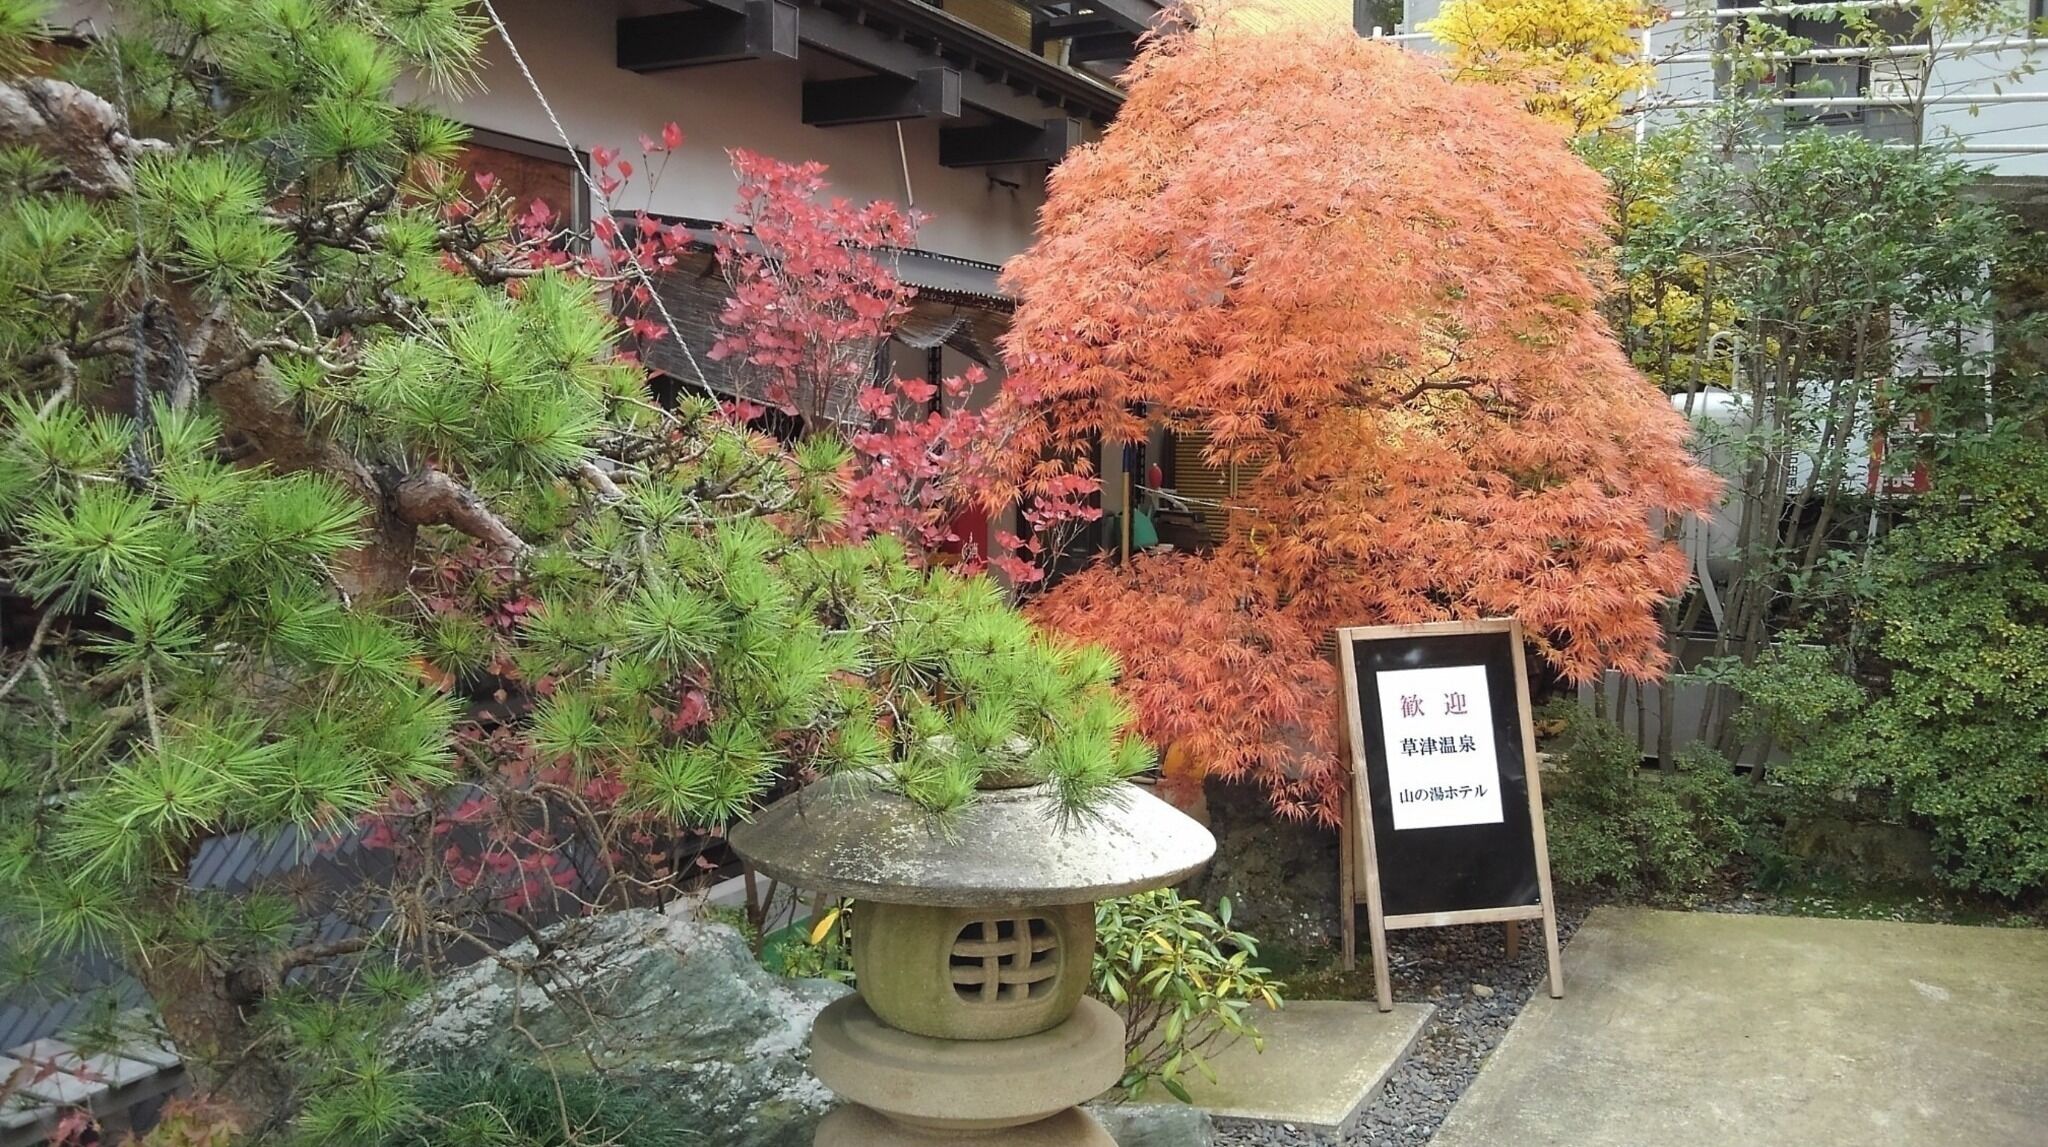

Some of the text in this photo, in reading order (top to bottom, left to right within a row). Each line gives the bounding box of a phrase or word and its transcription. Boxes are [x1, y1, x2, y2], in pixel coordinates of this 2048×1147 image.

[1400, 734, 1476, 757] 草津温泉
[1400, 785, 1488, 804] 山の湯ホテル
